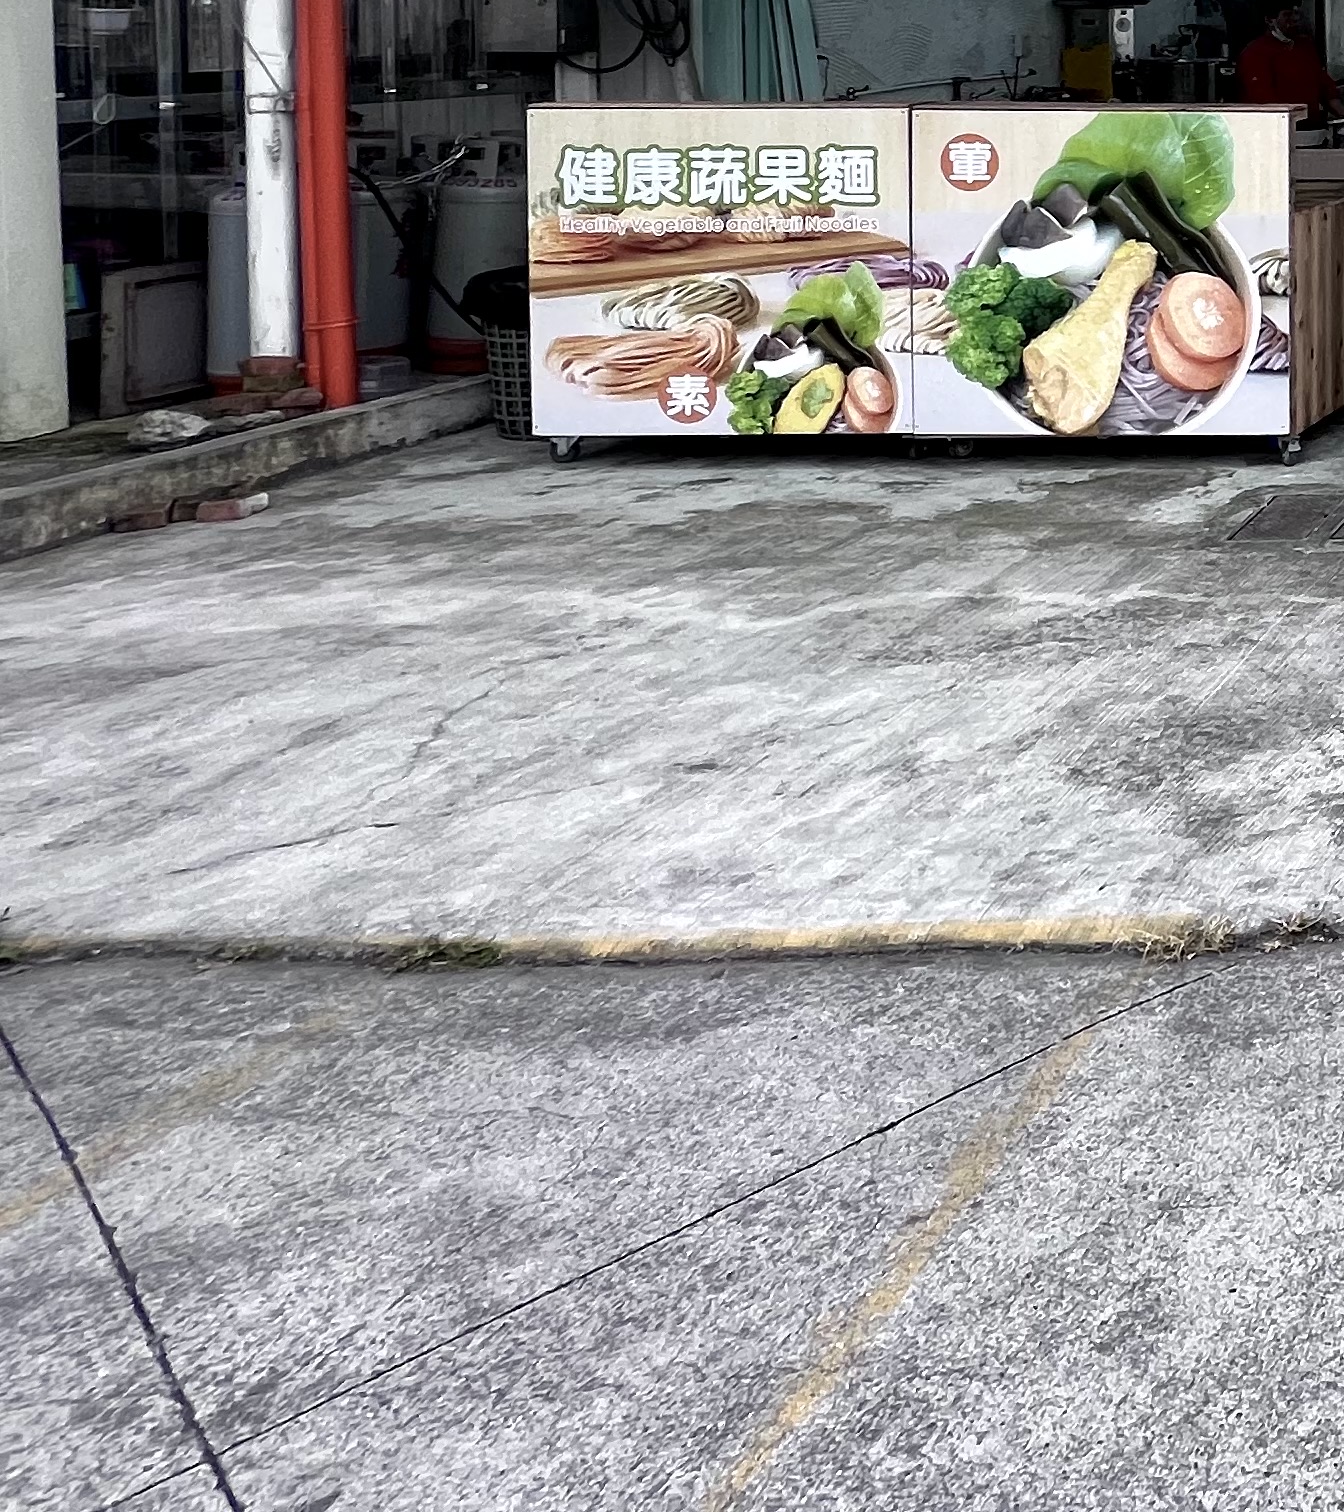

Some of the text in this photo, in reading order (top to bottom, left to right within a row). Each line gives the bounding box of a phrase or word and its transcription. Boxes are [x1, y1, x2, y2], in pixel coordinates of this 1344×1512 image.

[558, 143, 881, 207] 健康蔬果麵
[948, 141, 994, 186] 葷
[559, 216, 879, 236] Healthy Vegetable and Fruit Noodles
[665, 373, 713, 419] 素
